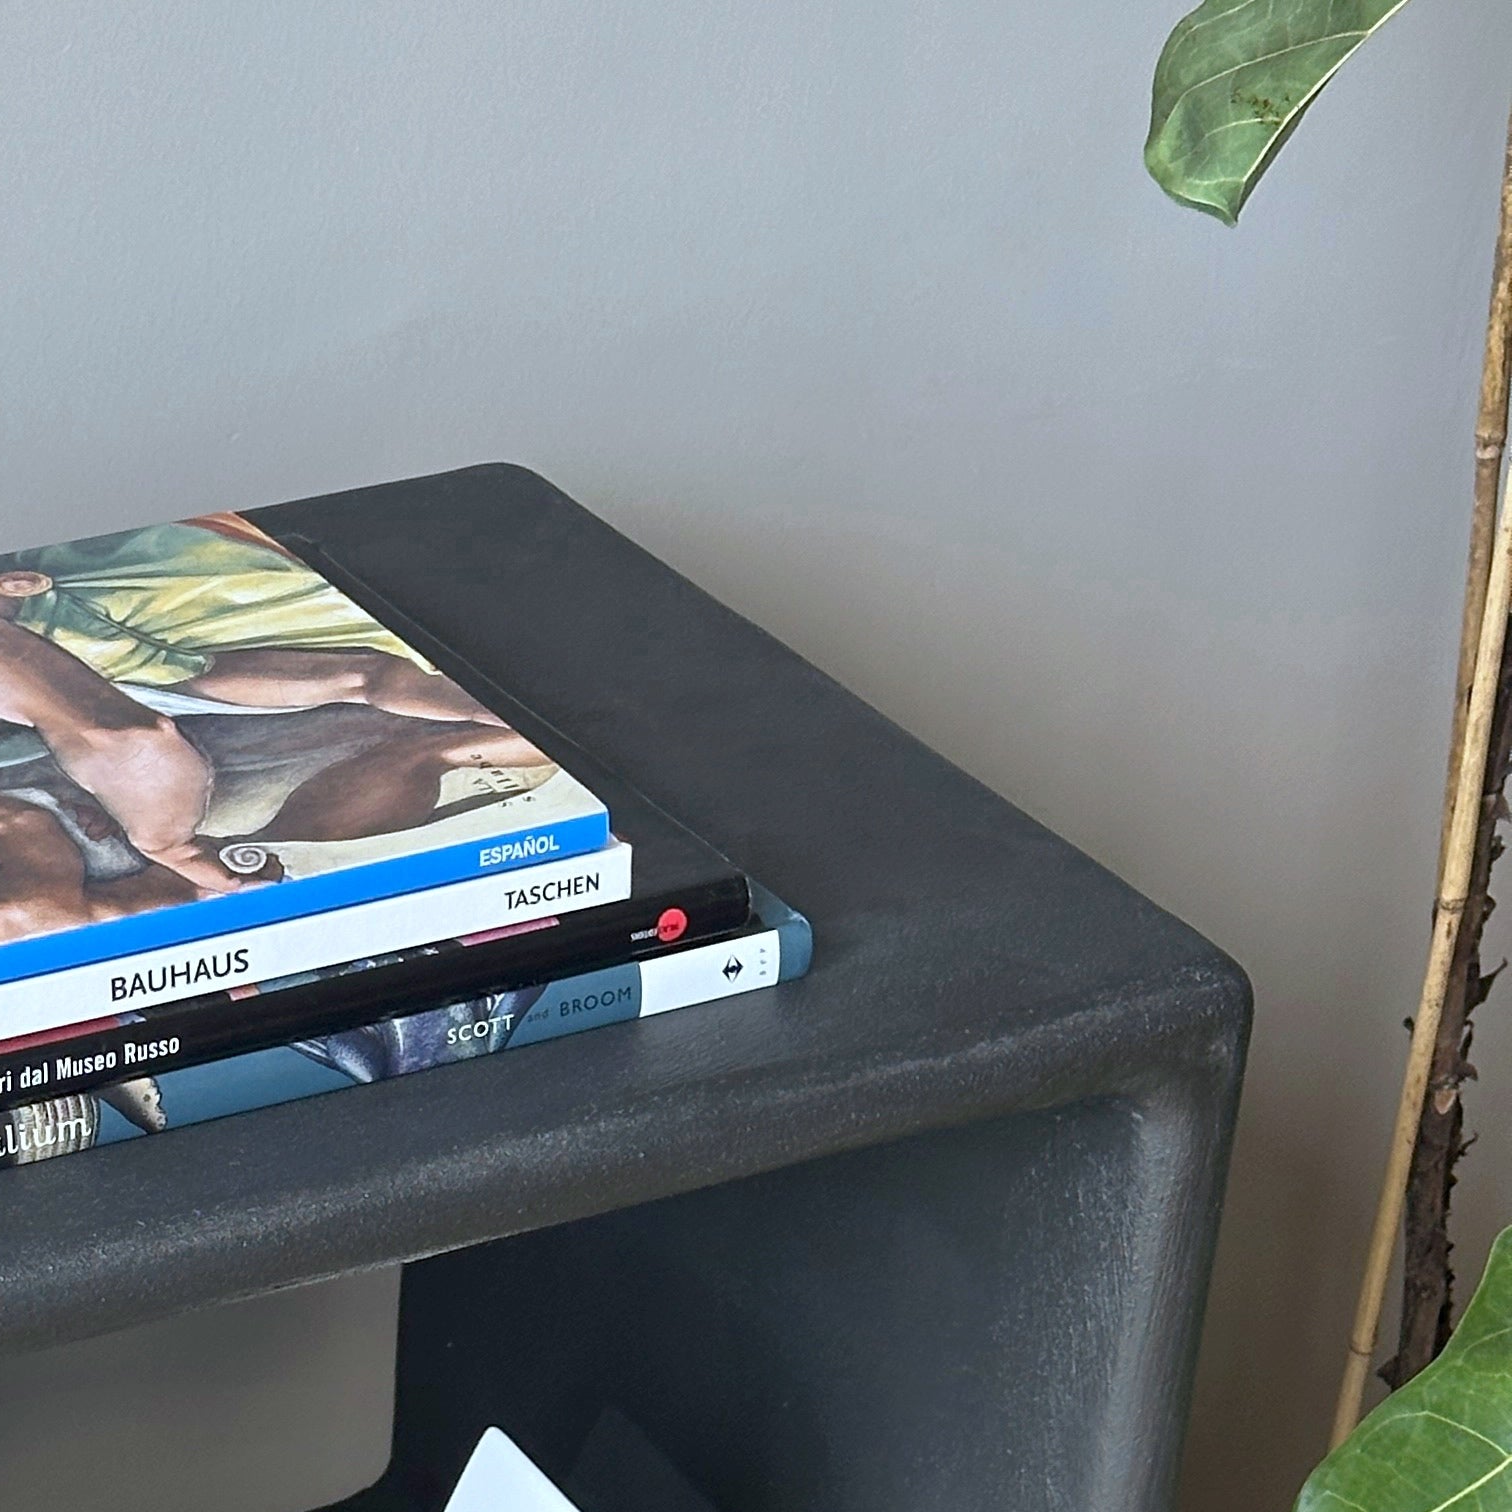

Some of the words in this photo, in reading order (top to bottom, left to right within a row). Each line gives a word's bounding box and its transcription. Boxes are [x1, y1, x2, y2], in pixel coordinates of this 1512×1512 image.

[479, 834, 561, 867] ESPAÑOL
[504, 872, 601, 910] TASCHEN
[111, 948, 250, 1002] BAUHAUS
[446, 1013, 516, 1045] SCOTT
[526, 1007, 550, 1023] and
[559, 985, 632, 1018] BROOM
[19, 1061, 49, 1094] dal
[55, 1050, 117, 1079] Museo
[123, 1036, 181, 1064] Russo
